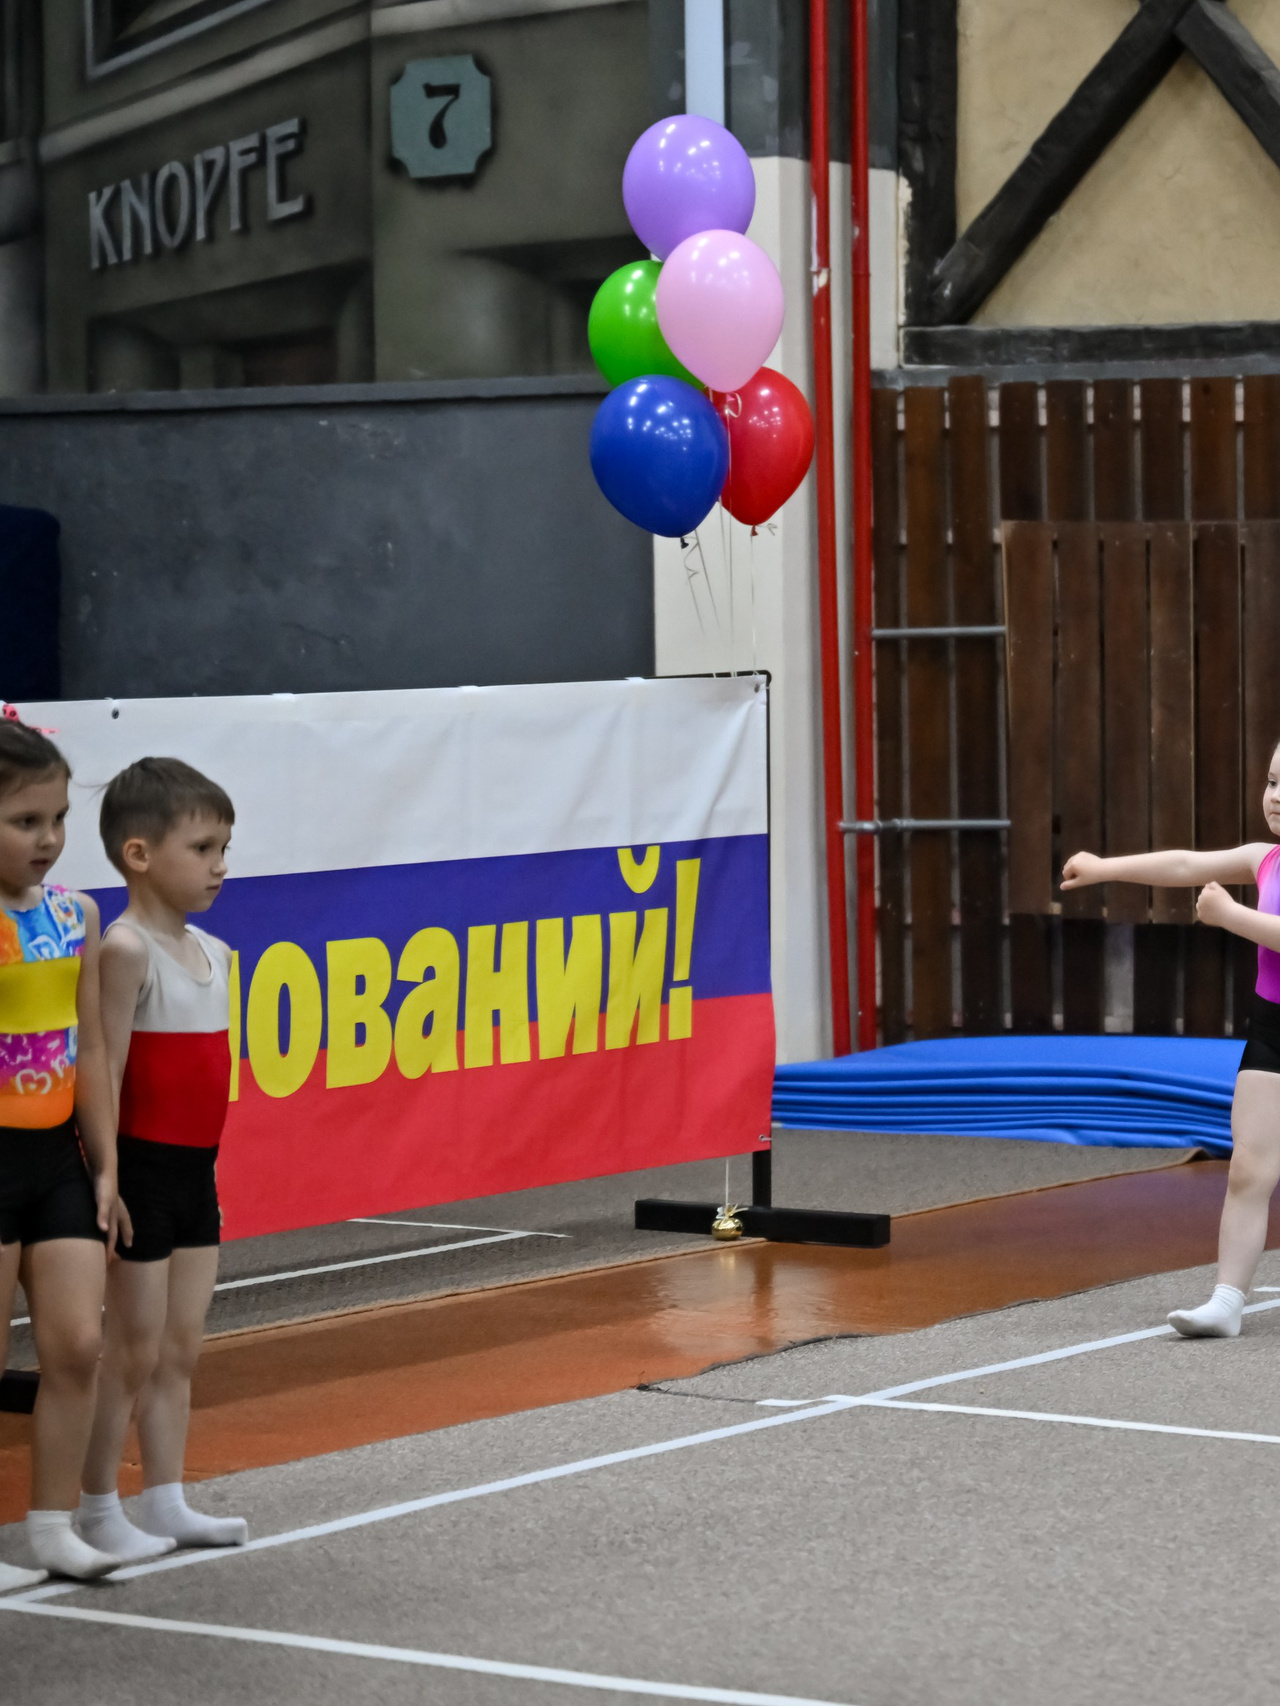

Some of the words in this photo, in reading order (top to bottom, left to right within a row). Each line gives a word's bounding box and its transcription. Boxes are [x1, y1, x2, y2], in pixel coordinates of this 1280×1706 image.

[422, 83, 461, 150] 7
[88, 117, 304, 270] KNOPFE
[229, 844, 701, 1103] ований!
